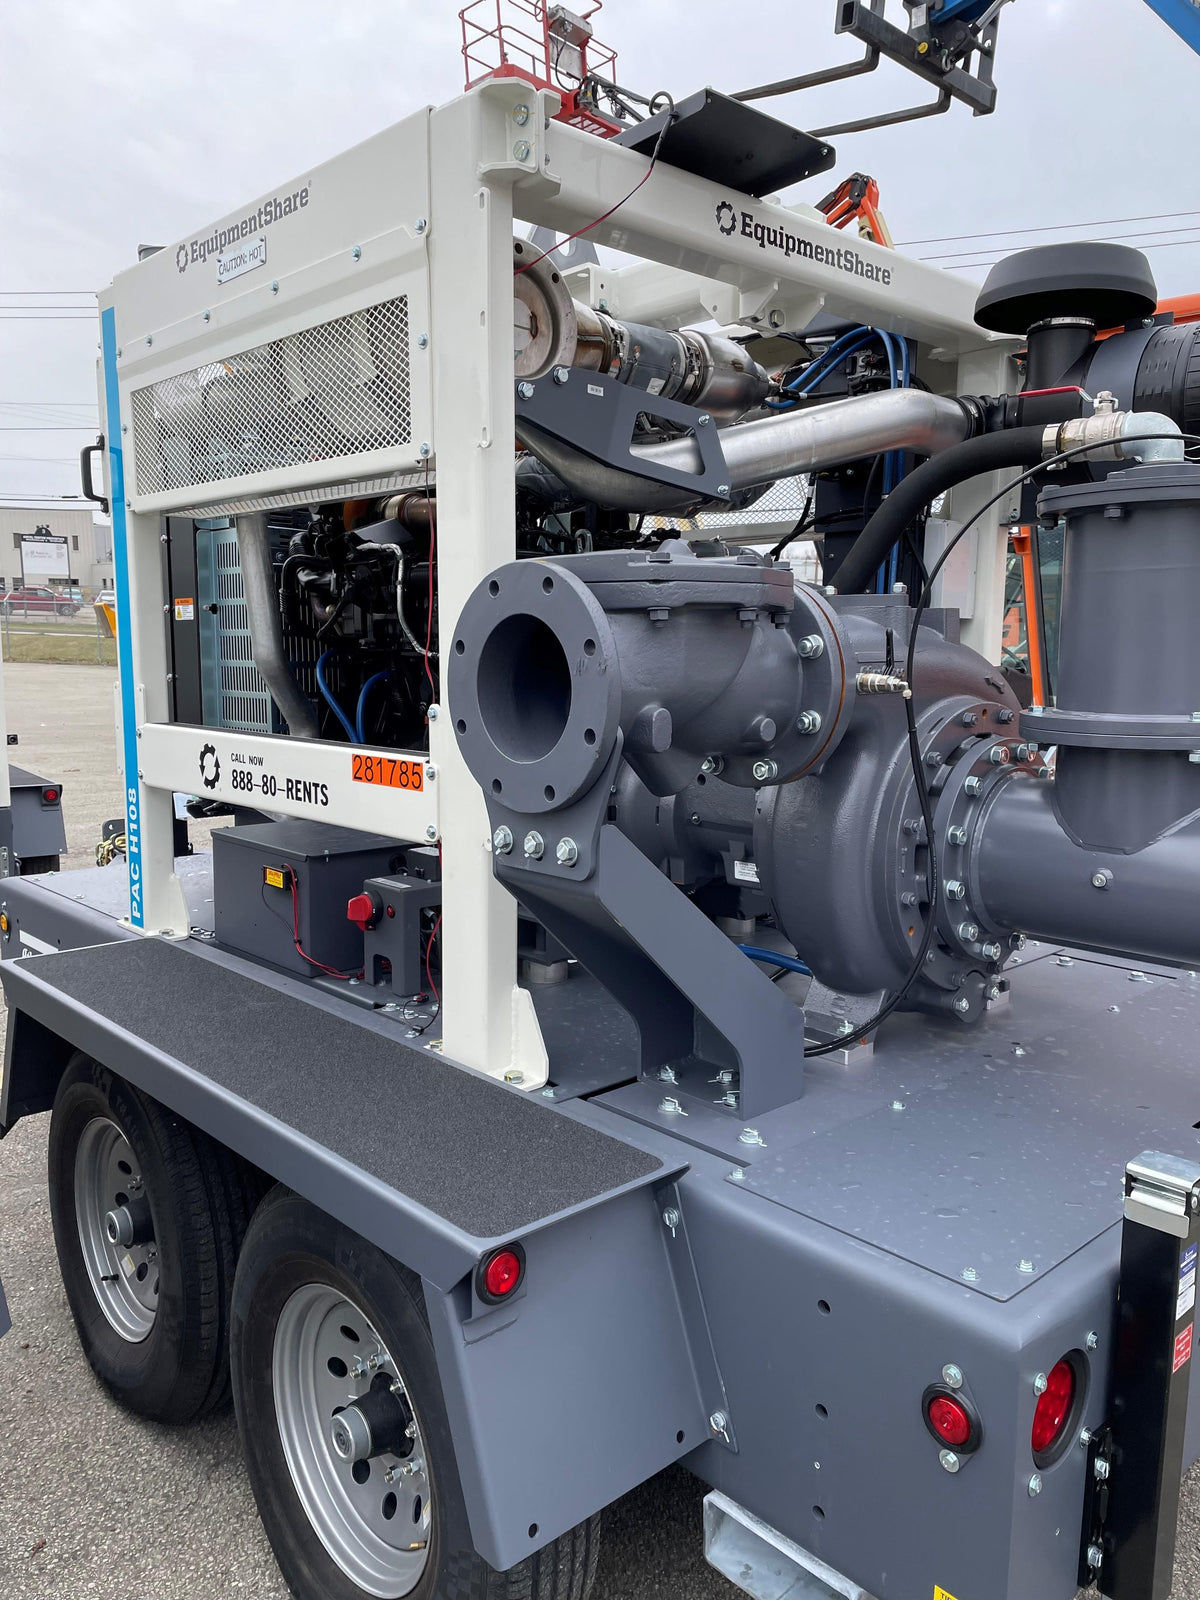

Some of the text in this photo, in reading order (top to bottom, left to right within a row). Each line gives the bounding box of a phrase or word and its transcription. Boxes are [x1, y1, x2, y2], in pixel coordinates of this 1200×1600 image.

[218, 245, 263, 275] CAUTION: HOT
[231, 753, 264, 767] CALL NOW
[353, 755, 423, 789] 281785
[232, 769, 329, 807] 888-80-RENTS
[128, 787, 141, 919] PAC H108
